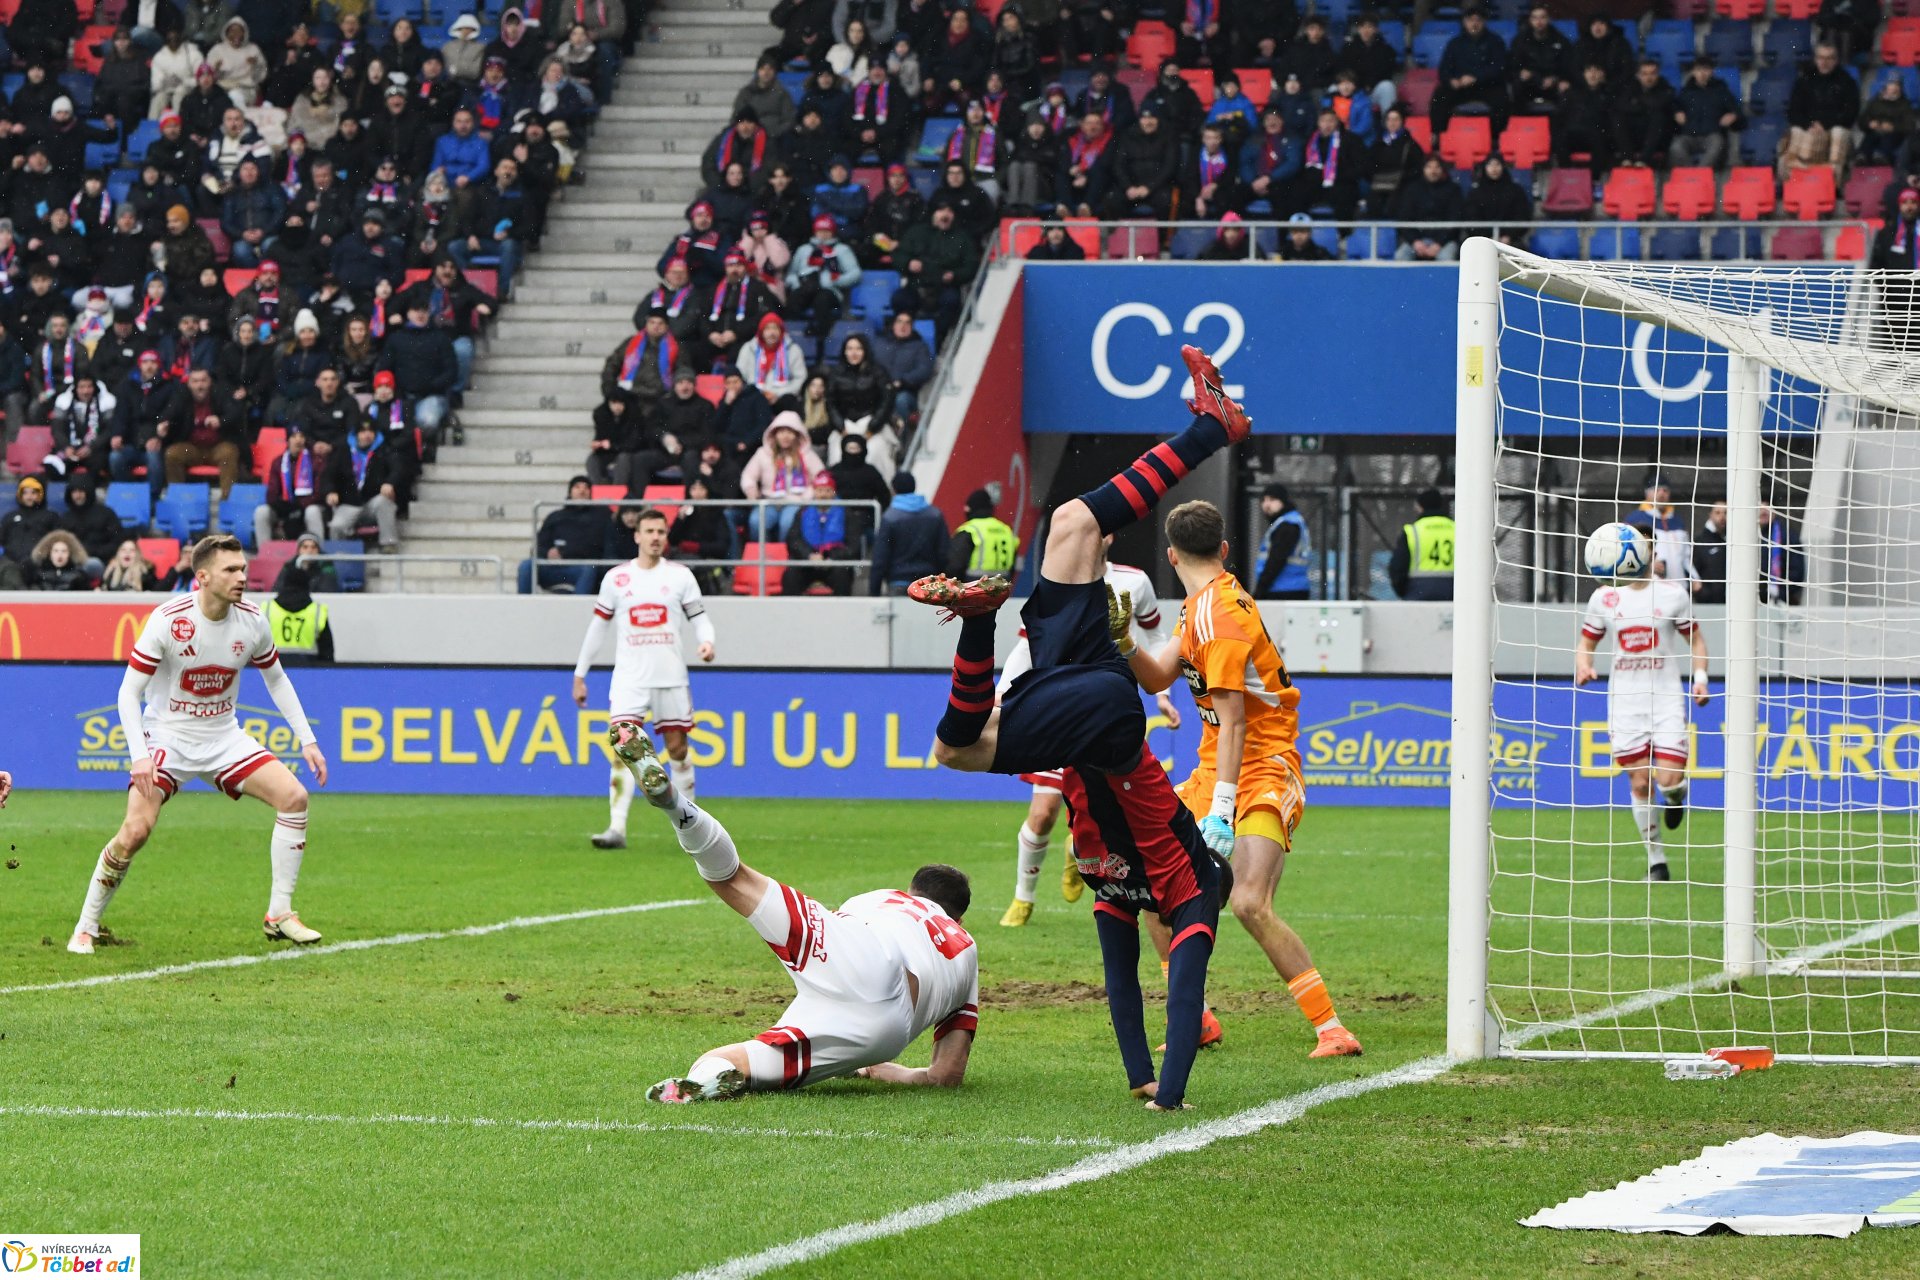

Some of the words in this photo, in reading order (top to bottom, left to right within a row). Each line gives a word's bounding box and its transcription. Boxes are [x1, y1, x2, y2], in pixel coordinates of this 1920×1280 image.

[1091, 302, 1245, 400] C2
[487, 505, 505, 519] 04
[1429, 539, 1453, 566] 43
[460, 562, 478, 576] 03
[282, 617, 304, 643] 67
[188, 671, 232, 682] master
[193, 680, 225, 691] good
[170, 696, 233, 717] TIPPMIX
[341, 694, 745, 767] BELVÁRSI
[772, 697, 857, 768] ÚJ
